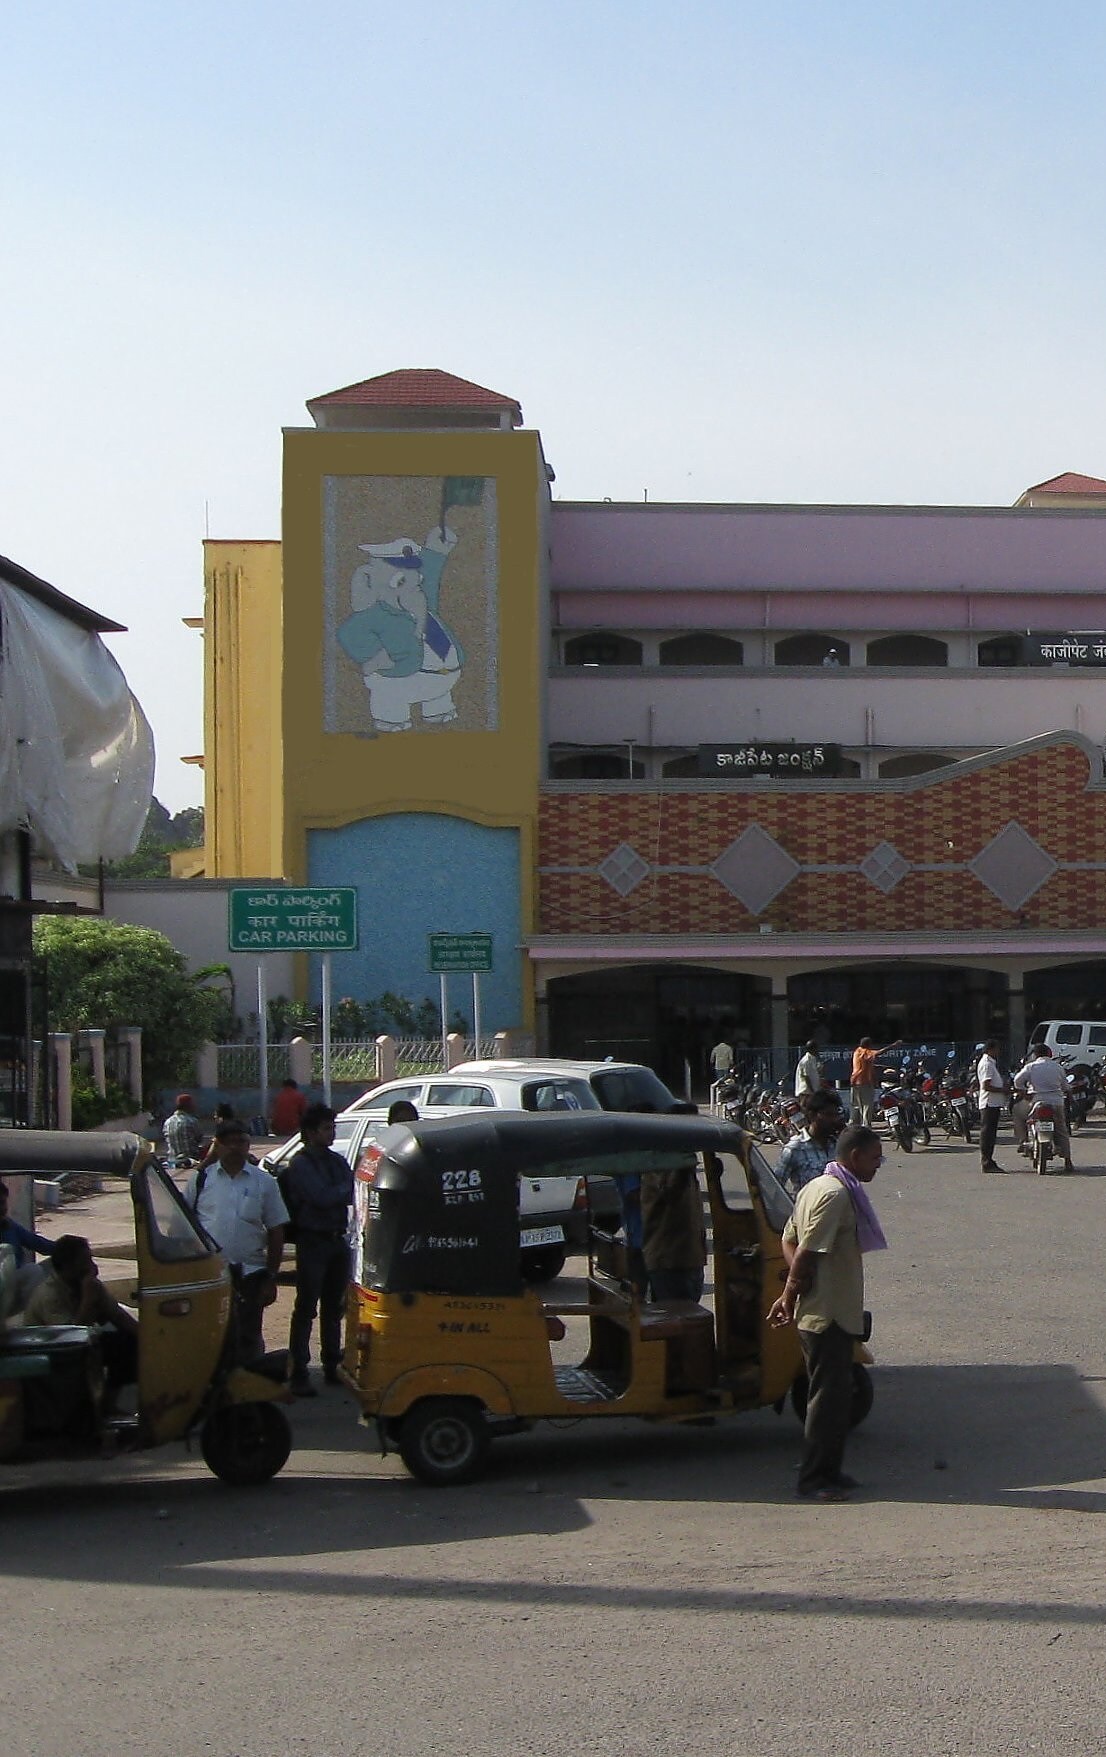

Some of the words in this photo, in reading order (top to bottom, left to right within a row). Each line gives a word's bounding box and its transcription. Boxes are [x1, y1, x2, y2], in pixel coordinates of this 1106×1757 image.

[1040, 638, 1089, 658] काजीपेट
[247, 916, 279, 928] कार
[238, 930, 272, 943] CAR
[276, 930, 348, 943] PARKING
[441, 1169, 482, 1190] 228
